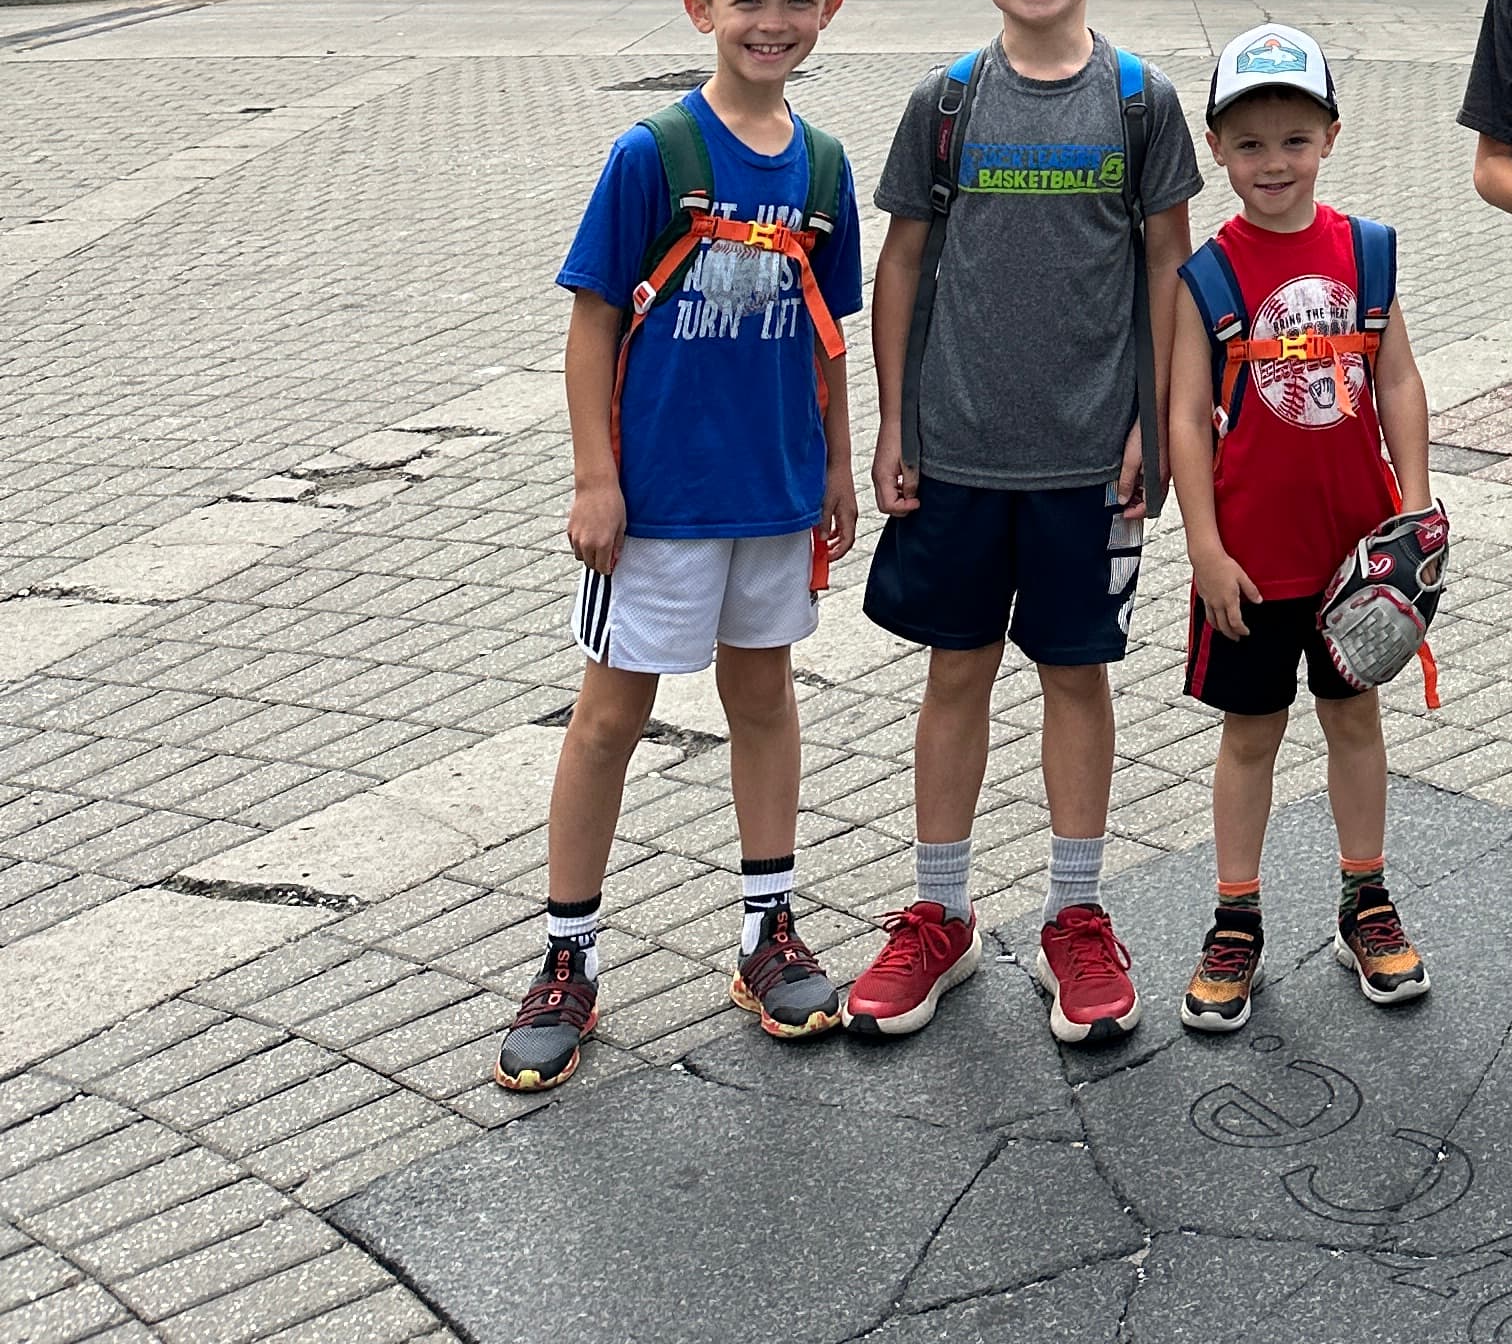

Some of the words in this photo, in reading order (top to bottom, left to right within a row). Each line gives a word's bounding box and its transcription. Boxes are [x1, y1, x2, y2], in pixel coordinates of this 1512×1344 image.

[978, 169, 1097, 189] BASKETBALL
[672, 298, 743, 340] TURN
[1272, 312, 1302, 333] BRING
[1306, 307, 1325, 322] THE
[1329, 307, 1349, 320] HEAT
